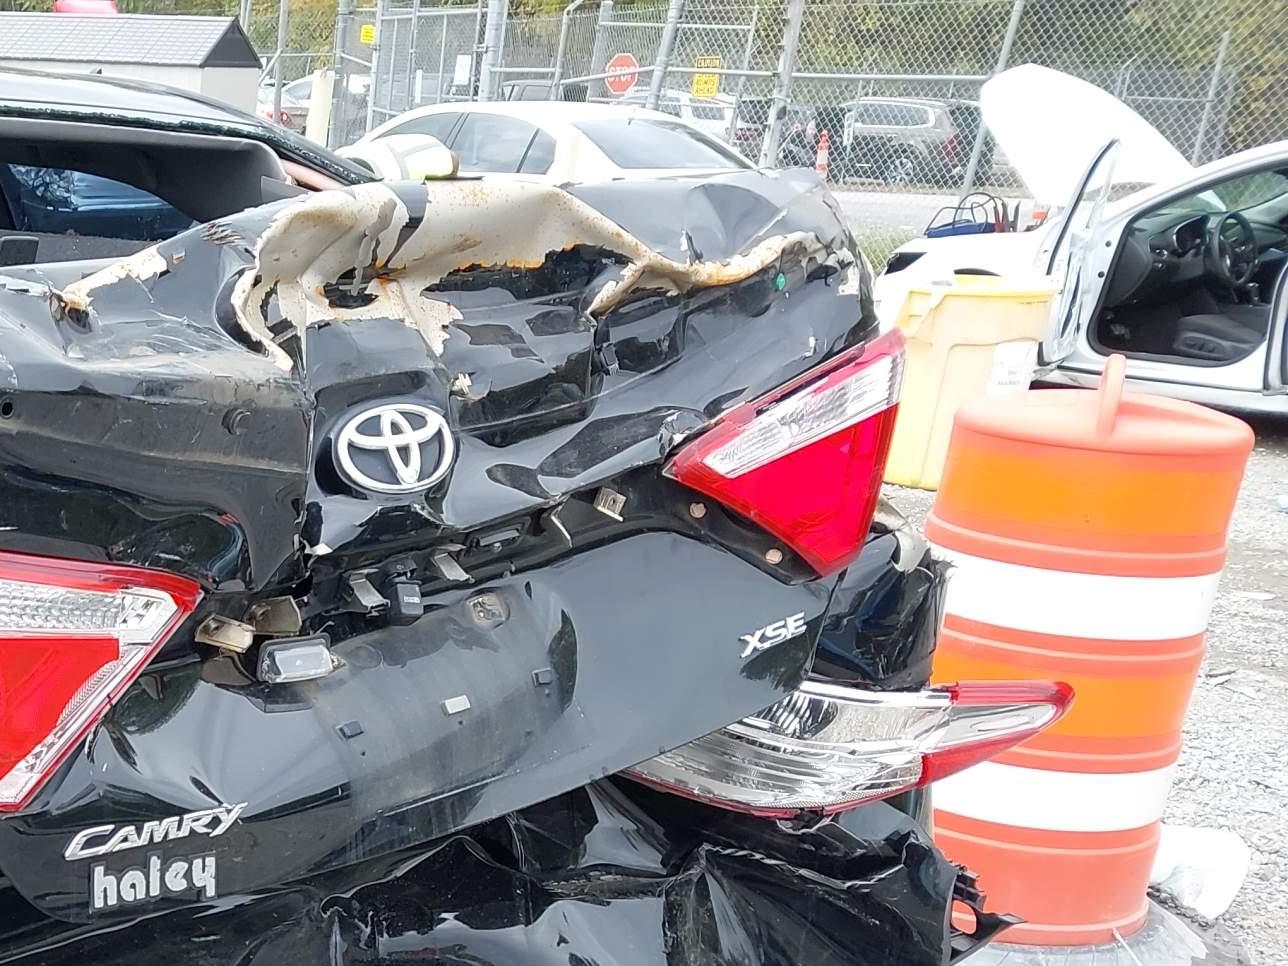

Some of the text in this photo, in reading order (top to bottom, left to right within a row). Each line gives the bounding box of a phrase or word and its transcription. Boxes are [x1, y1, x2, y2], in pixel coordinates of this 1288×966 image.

[607, 66, 635, 82] STOP
[738, 612, 808, 658] XSE
[64, 802, 248, 861] CAMRY
[94, 855, 217, 909] haley
